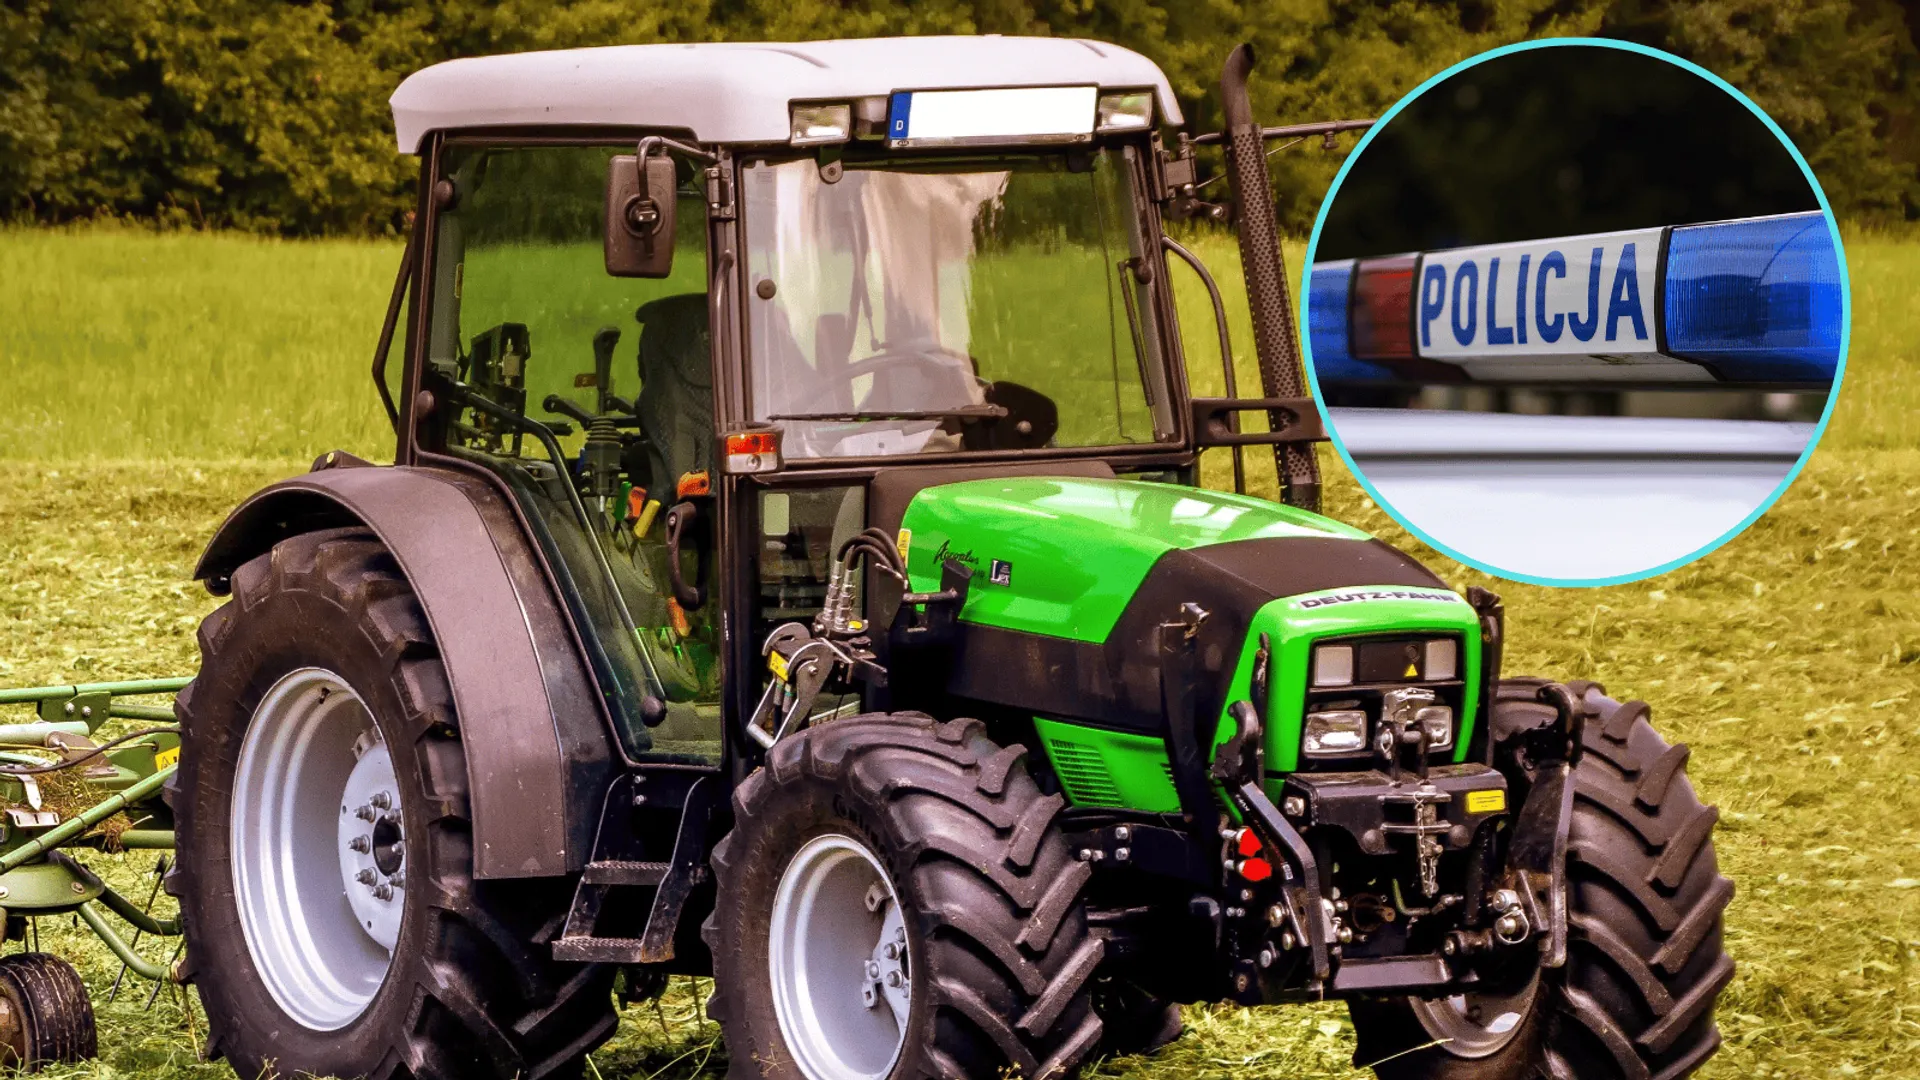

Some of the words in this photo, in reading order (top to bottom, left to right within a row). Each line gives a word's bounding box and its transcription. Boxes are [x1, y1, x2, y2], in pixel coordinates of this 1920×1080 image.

[895, 120, 904, 131] D
[1420, 242, 1649, 347] POLICJA
[1301, 591, 1459, 608] DEUTZ-FAHR
